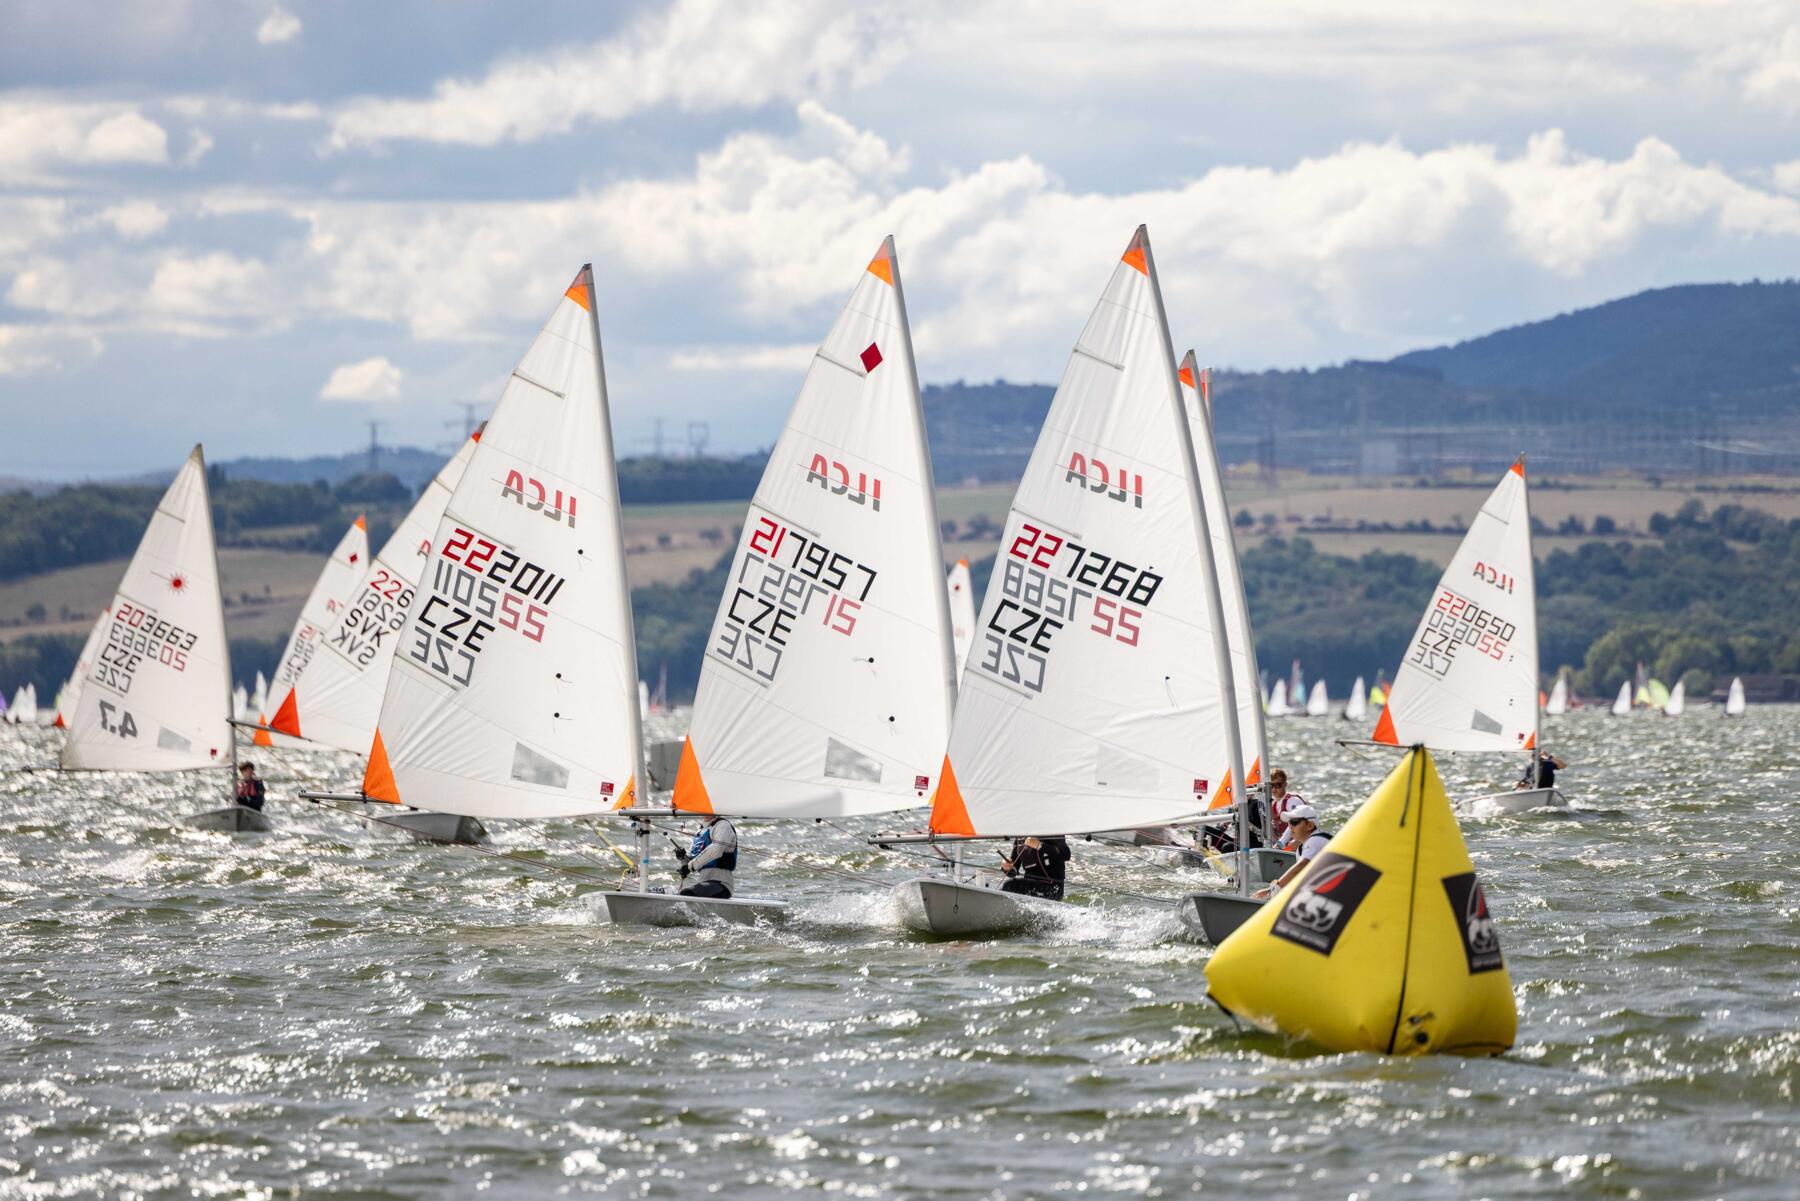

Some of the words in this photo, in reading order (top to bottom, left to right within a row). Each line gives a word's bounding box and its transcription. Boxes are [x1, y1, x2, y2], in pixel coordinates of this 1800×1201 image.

[441, 527, 566, 605] 222011
[749, 516, 878, 602] 217957
[1009, 523, 1164, 607] 227268
[369, 570, 415, 608] 226
[116, 603, 198, 652] 203663
[345, 608, 390, 648] SVK
[418, 595, 496, 653] CZE
[728, 587, 797, 646] CZE
[988, 598, 1064, 654] CZE
[1420, 627, 1462, 658] CZE
[1437, 591, 1516, 642] 220650
[101, 643, 142, 673] CZE
